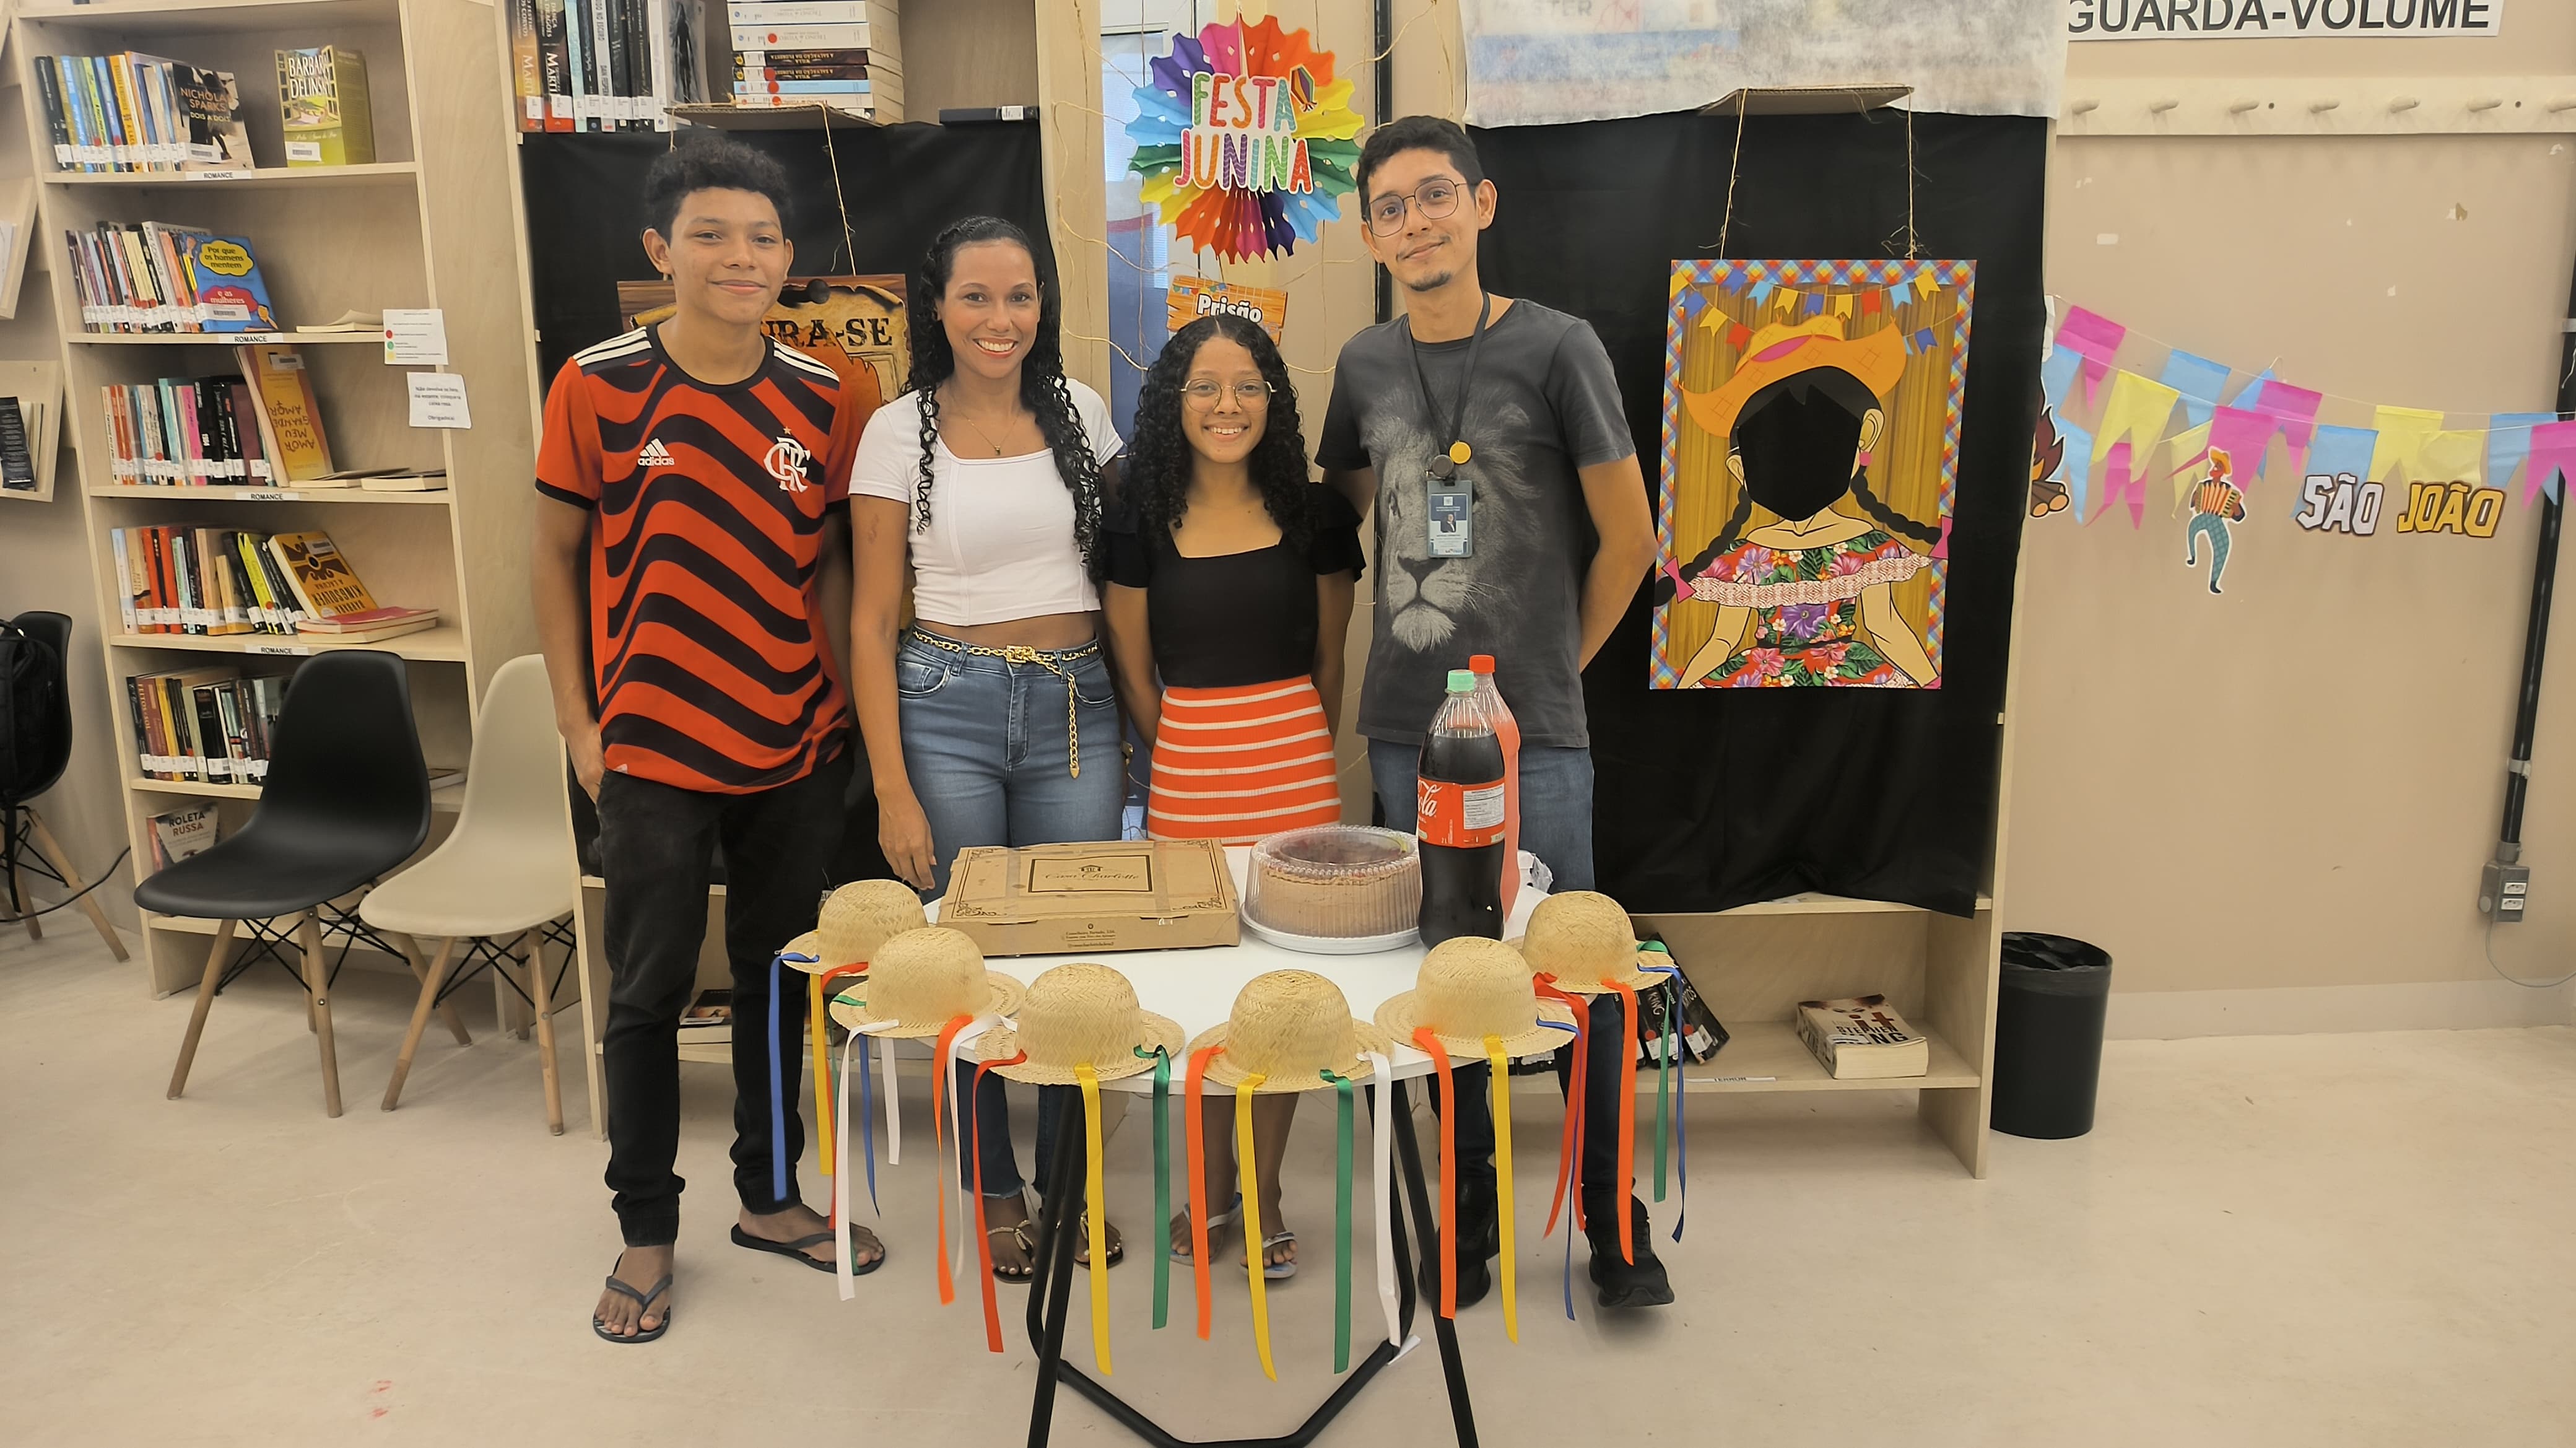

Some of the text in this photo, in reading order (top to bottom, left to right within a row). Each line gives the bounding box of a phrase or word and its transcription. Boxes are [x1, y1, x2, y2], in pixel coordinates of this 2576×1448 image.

[2069, 0, 2489, 33] GUARDA-VOLUME
[288, 52, 331, 78] BARBARA
[546, 52, 559, 94] MARTI
[522, 55, 533, 95] MARTI
[290, 74, 333, 98] DELINSKY
[180, 87, 228, 102] NICHOLA
[1194, 73, 1297, 132] FESTA
[189, 98, 227, 112] SPARKS
[189, 111, 206, 120] DOIS
[214, 115, 231, 123] DOIS
[1175, 129, 1313, 193] JUNINA
[1197, 294, 1262, 323] Prisão
[269, 404, 302, 416] AMOR
[273, 416, 310, 427] GRANDE
[285, 428, 307, 438] MEU
[284, 438, 315, 453] AMOR
[637, 456, 675, 466] adidas
[2297, 474, 2506, 538] SÃO JOÃO
[314, 581, 339, 590] LACUNA
[311, 585, 364, 606] KINGSOLVER
[335, 600, 366, 614] BARBARA
[168, 811, 206, 827] ROLETA
[172, 822, 204, 837] RUSSA
[1648, 992, 1665, 1015] KING
[1849, 1011, 1895, 1030] it
[1836, 1025, 1899, 1034] STEPHEN
